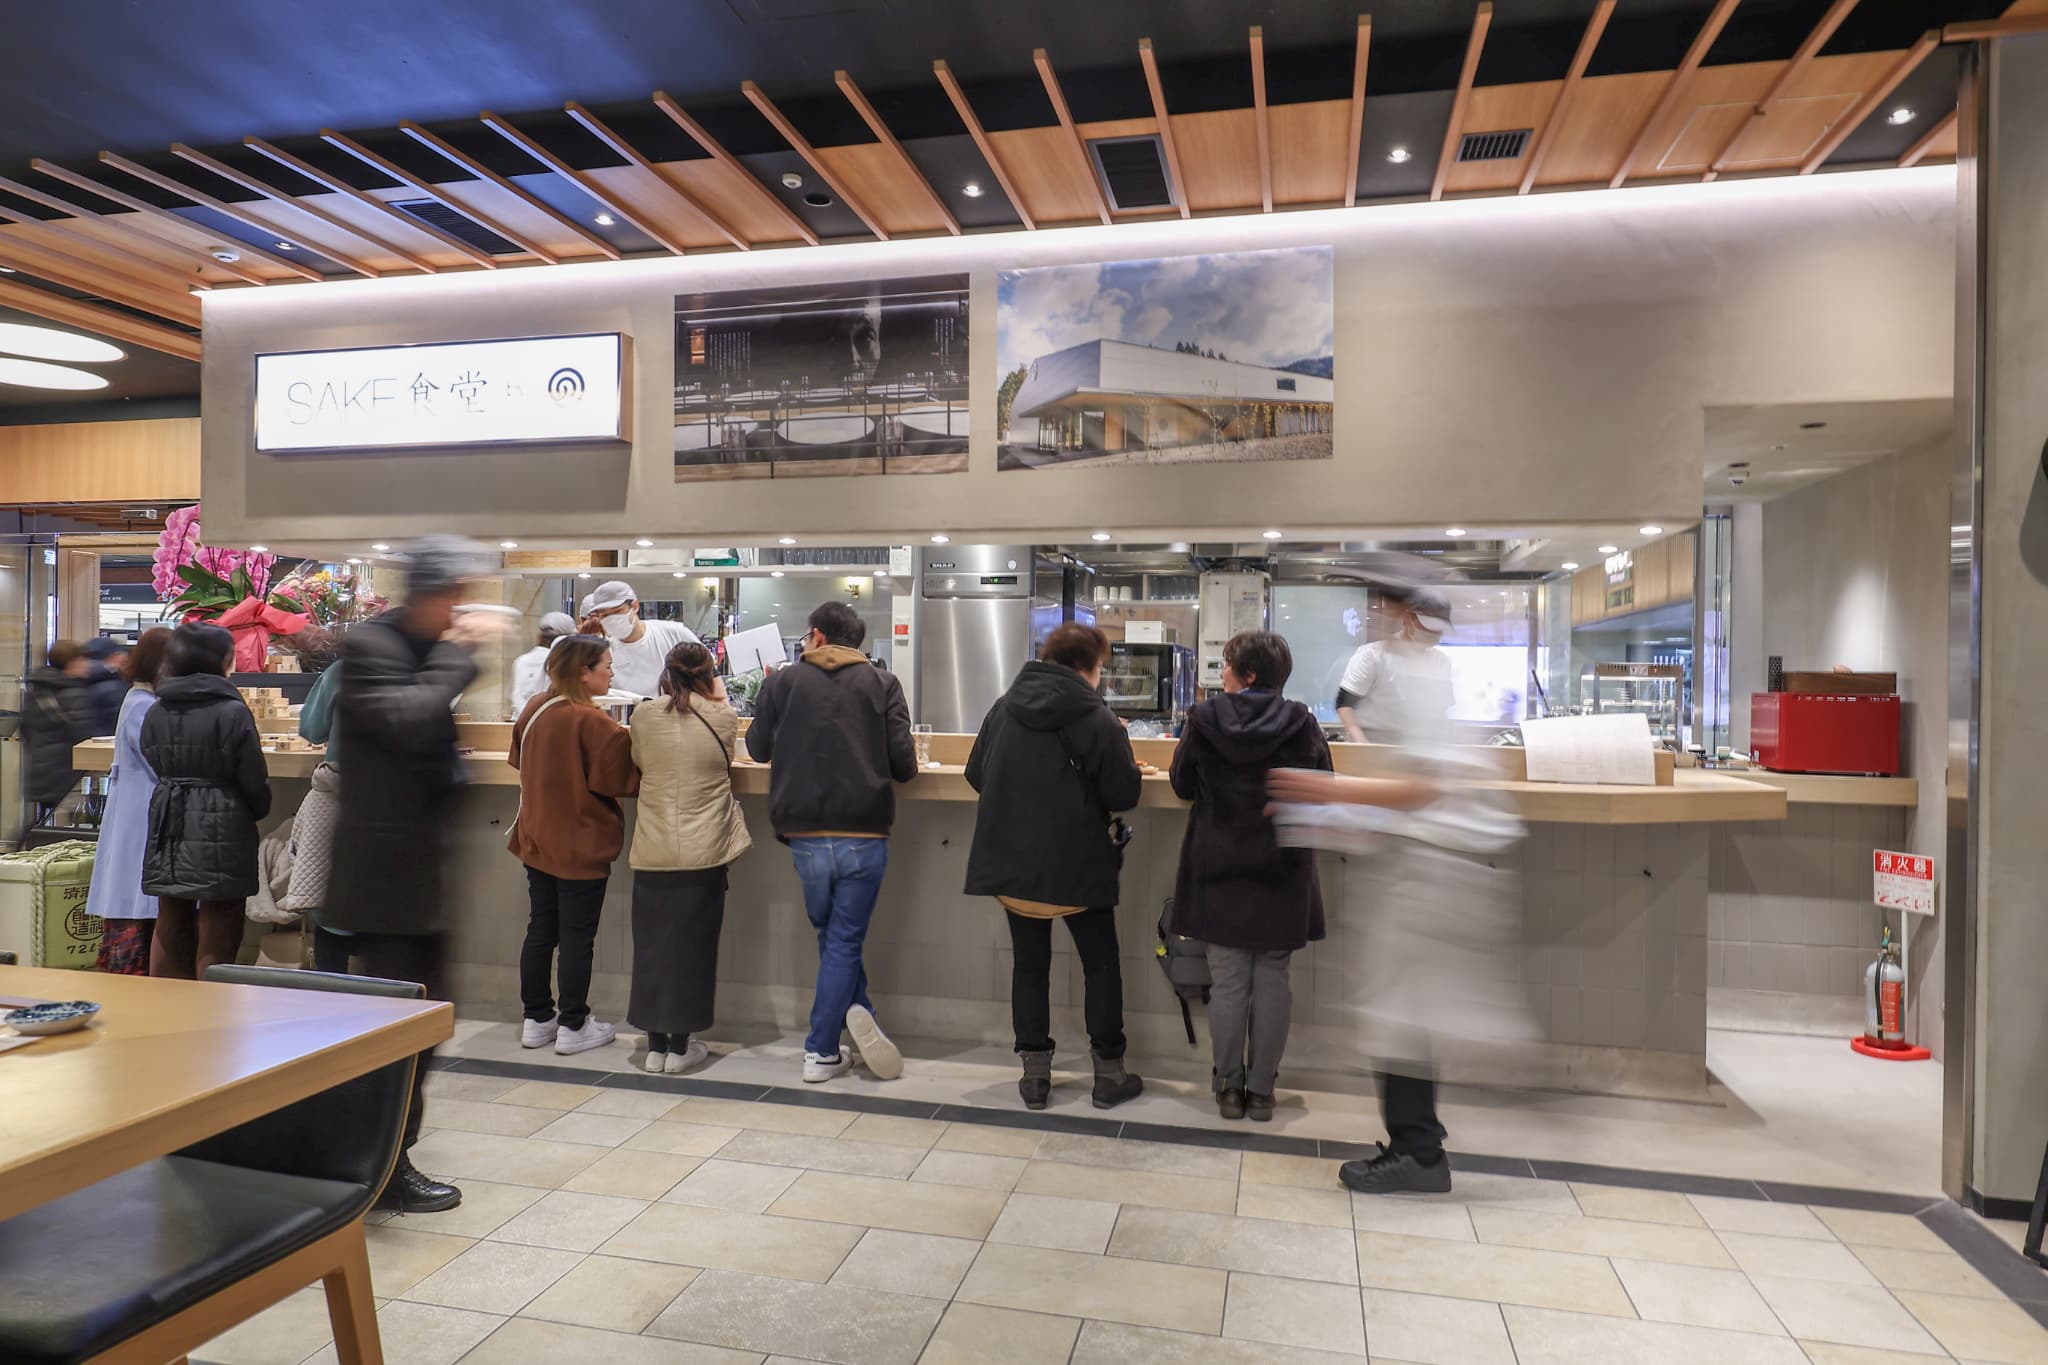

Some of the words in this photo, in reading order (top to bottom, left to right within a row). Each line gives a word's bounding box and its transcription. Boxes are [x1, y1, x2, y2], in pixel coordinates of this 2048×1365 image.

[408, 369, 487, 417] 食堂
[1880, 853, 1926, 873] 消火器
